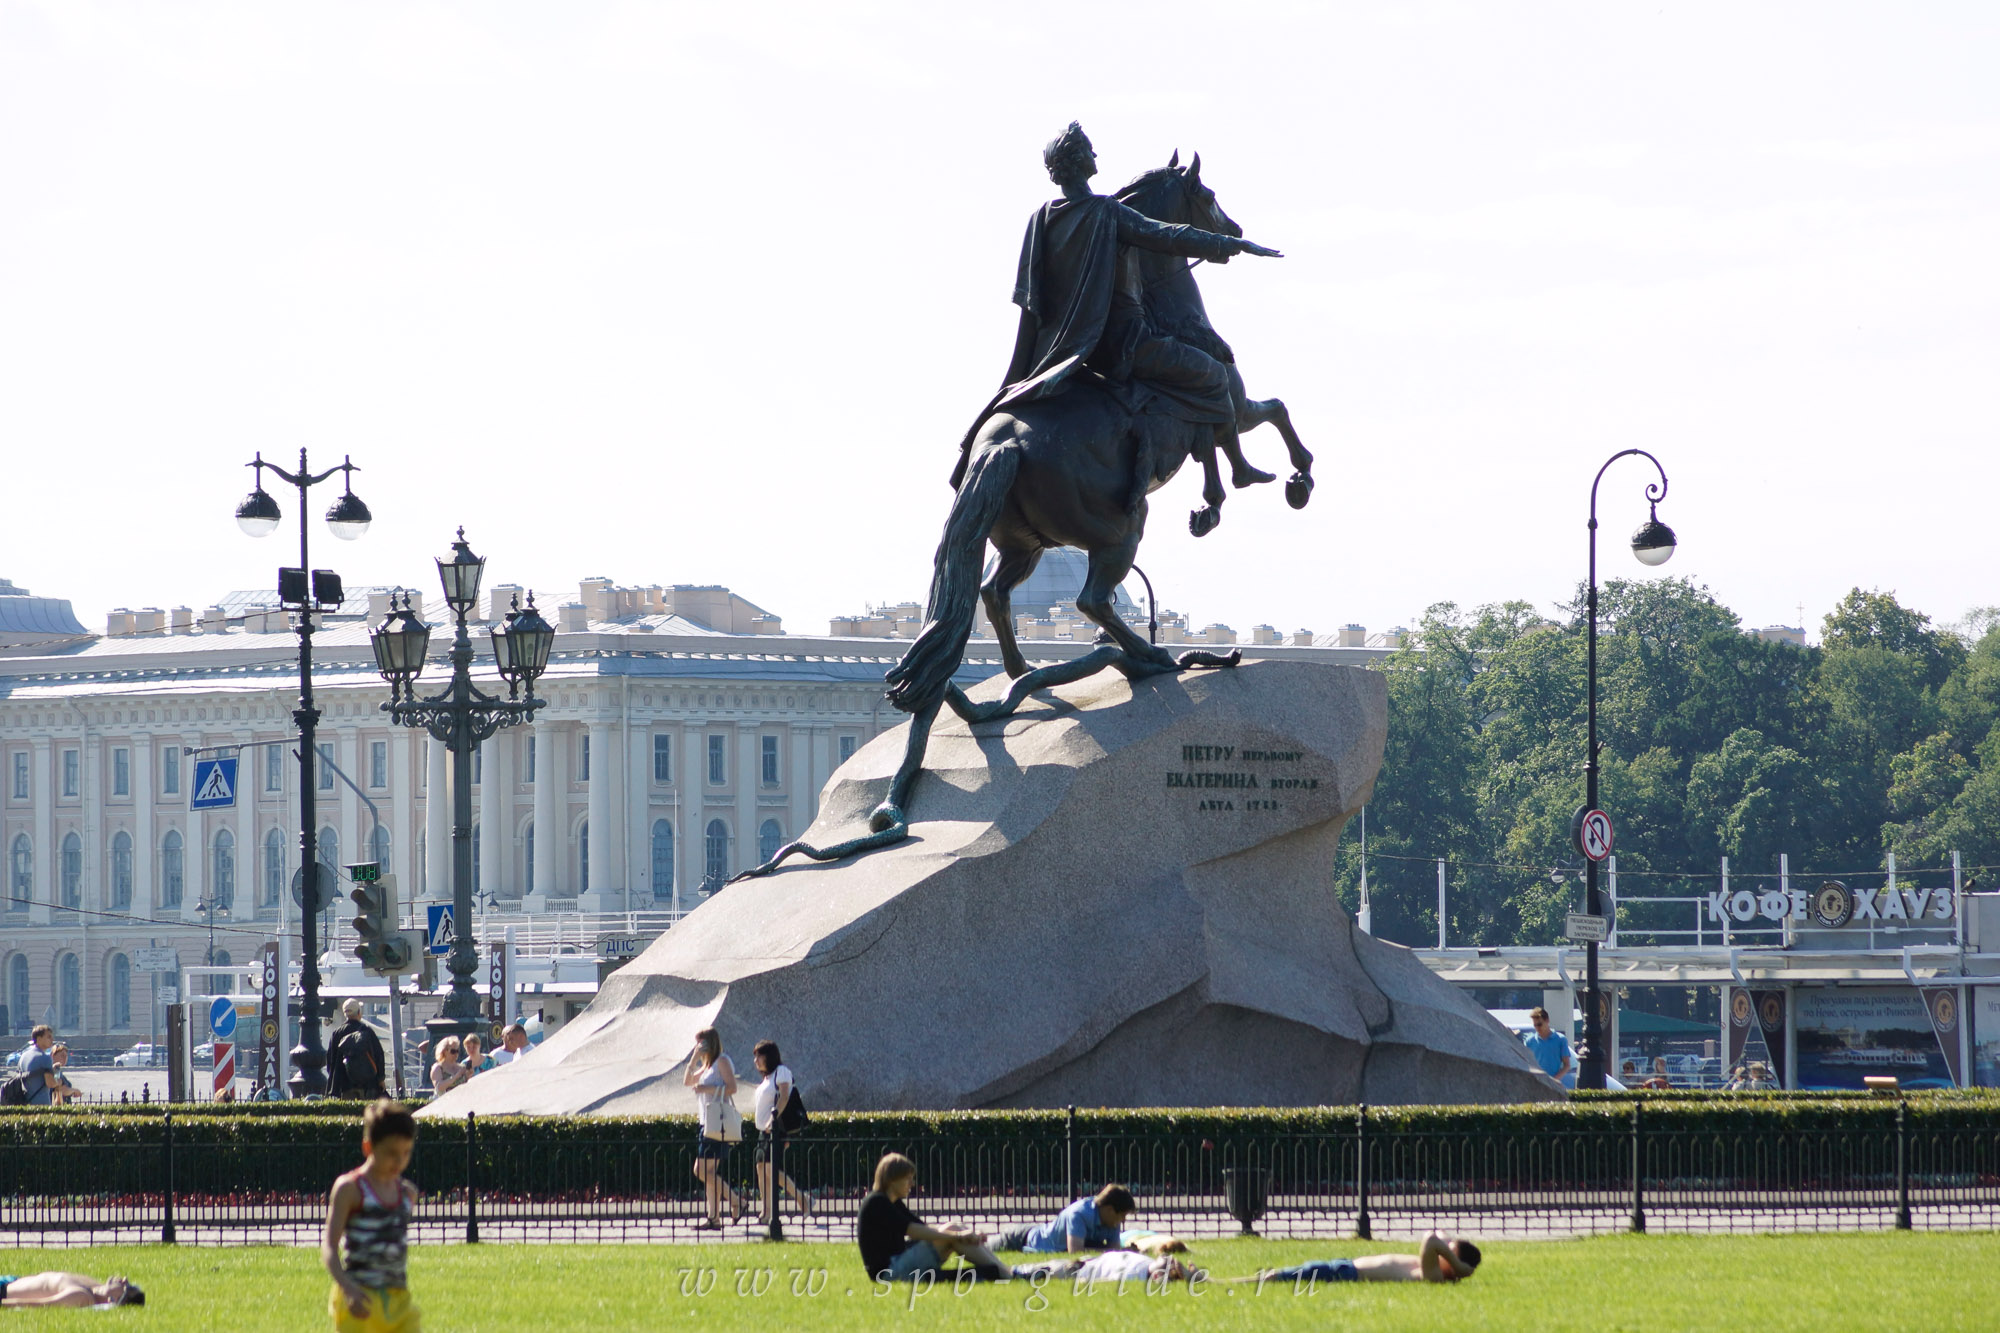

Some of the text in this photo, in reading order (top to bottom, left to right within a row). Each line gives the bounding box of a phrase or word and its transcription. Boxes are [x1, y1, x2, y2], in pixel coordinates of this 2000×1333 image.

[1182, 745, 1235, 761] ПЕТРУ
[1166, 772, 1319, 790] ЕКАТЕРИНА ВТОРАЯ
[1708, 890, 1809, 922] КОФЕ
[1853, 888, 1954, 920] ХАУЗ
[605, 938, 635, 955] ДПС
[264, 951, 276, 1016] КОФЕ
[491, 951, 503, 1016] КОФЕ
